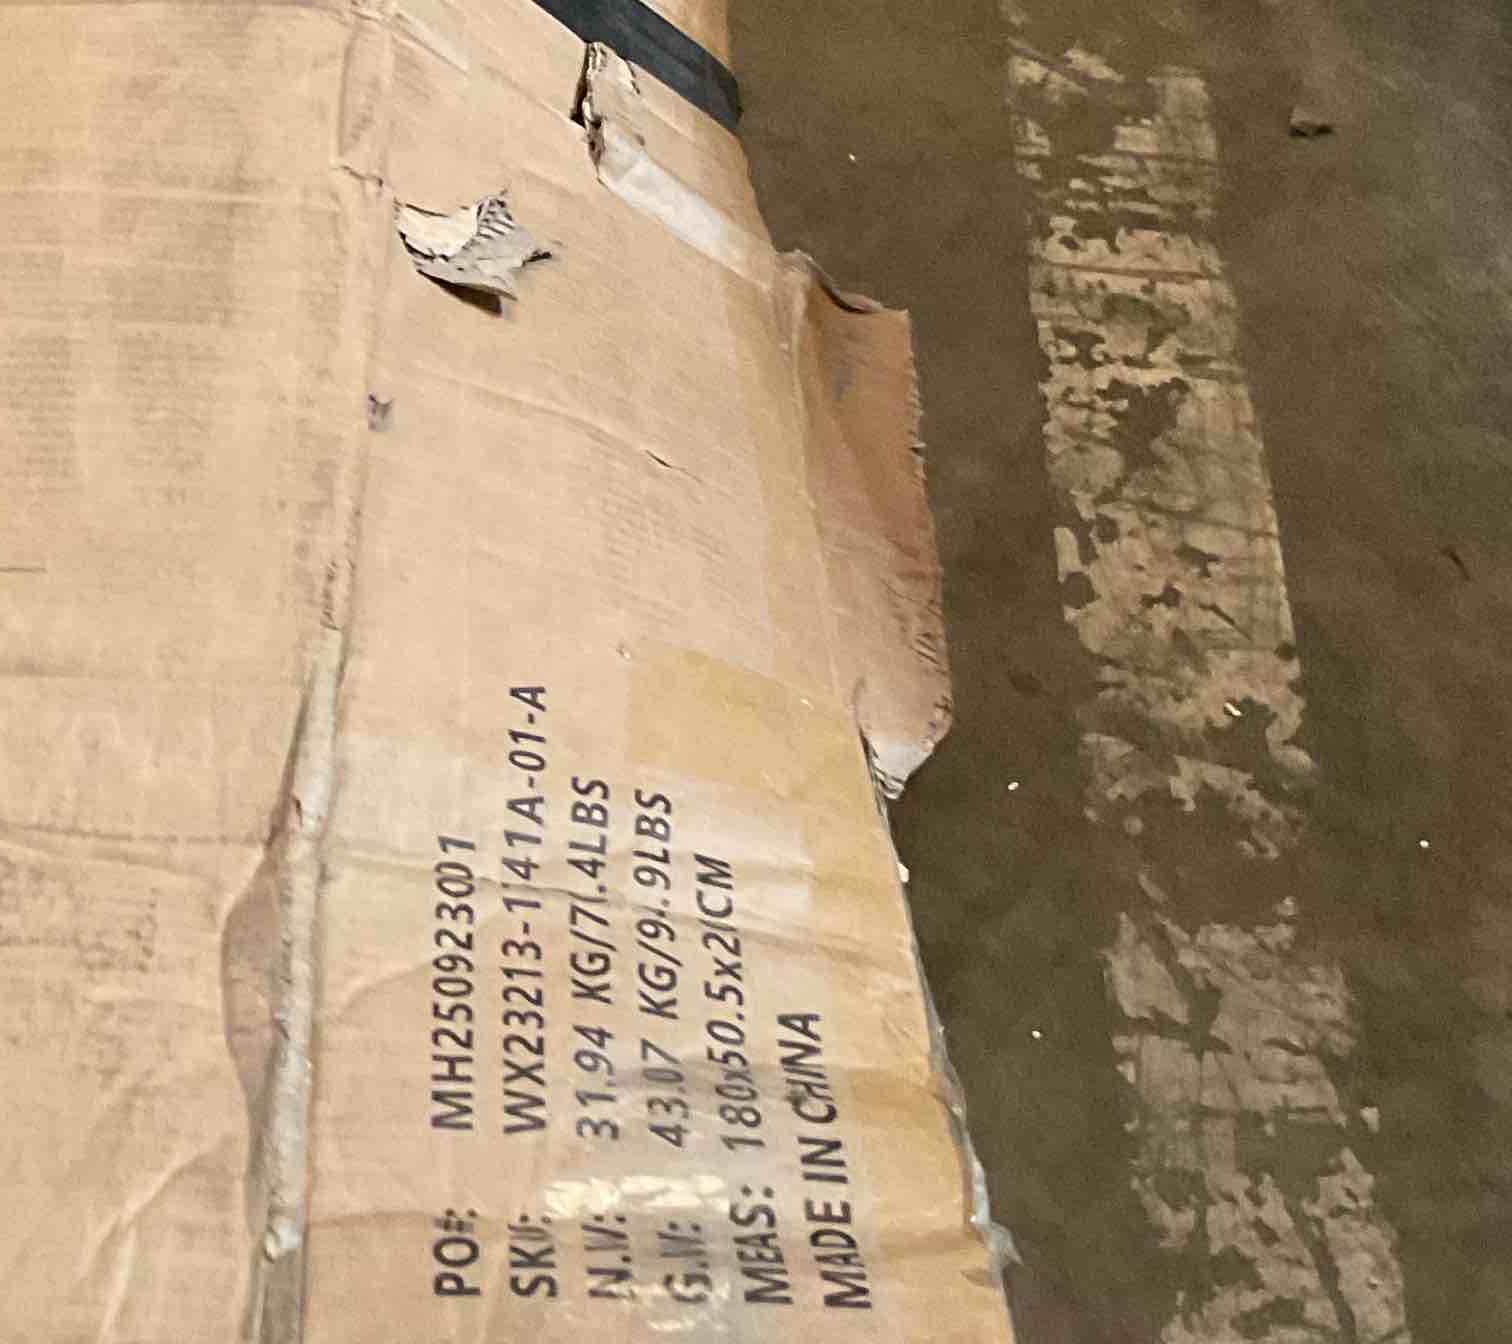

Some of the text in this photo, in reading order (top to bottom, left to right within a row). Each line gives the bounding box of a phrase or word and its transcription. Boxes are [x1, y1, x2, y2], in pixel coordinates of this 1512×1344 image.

[501, 685, 549, 1135] WX23213-141A-01-A
[566, 775, 618, 1006] KG/7.4LBS
[632, 787, 684, 1021] KG/9.9LBS
[430, 833, 483, 1298] PO#: MH250923001
[572, 1023, 620, 1142] 31.94
[640, 1037, 689, 1149] 43.07
[693, 852, 794, 1306] MEAS: 180x50.5x2CM
[775, 1011, 873, 1311] MADE IN CHINA
